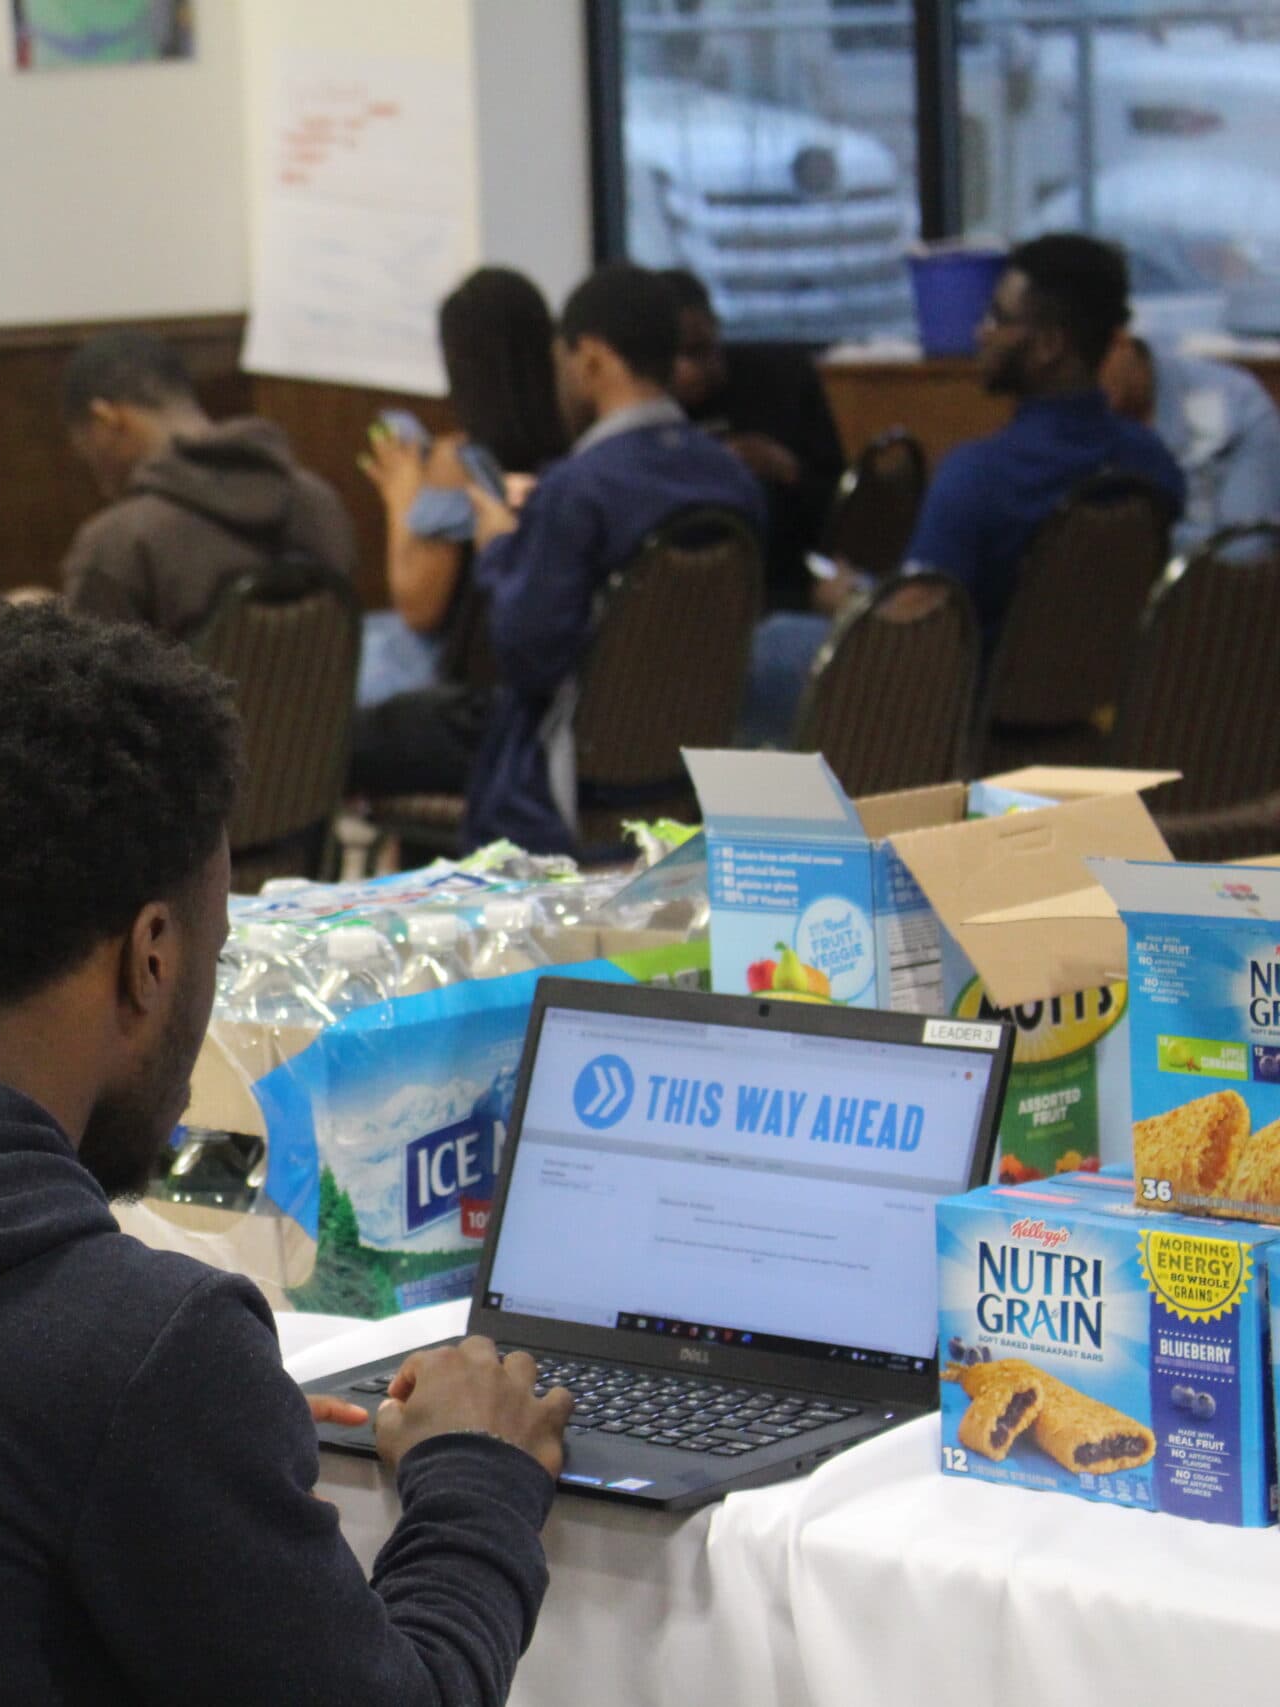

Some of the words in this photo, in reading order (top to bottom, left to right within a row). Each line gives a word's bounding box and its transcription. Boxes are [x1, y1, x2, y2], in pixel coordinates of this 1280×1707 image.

[1162, 944, 1190, 955] FRUIT
[930, 1024, 982, 1042] LEADER
[984, 1029, 993, 1042] 3
[1019, 1088, 1081, 1115] ASSORTED
[646, 1075, 723, 1128] THIS
[735, 1085, 808, 1138] WAY
[810, 1095, 925, 1152] AHEAD
[1033, 1106, 1068, 1127] FRUIT
[418, 1133, 482, 1208] ICE
[1142, 1177, 1172, 1202] 36
[1011, 1219, 1069, 1248] Kellogg's
[1160, 1238, 1230, 1259] MORNING
[978, 1241, 1102, 1300] NUTRI
[1157, 1252, 1233, 1277] ENERGY
[1187, 1274, 1230, 1289] WHOLE
[1174, 1285, 1213, 1303] GRAINS
[977, 1294, 1103, 1350] GRAIN
[679, 1347, 709, 1364] DELL
[979, 1335, 999, 1344] SOFT
[1000, 1338, 1028, 1350] BAKED
[1030, 1342, 1078, 1358] BREAKFAST
[1080, 1350, 1104, 1362] BARS
[1160, 1338, 1231, 1364] BLUEBERRY
[1168, 1434, 1194, 1447] REAL
[1196, 1439, 1225, 1451] FRUIT
[1178, 1428, 1196, 1437] MADE
[1197, 1431, 1215, 1440] WITH
[943, 1447, 969, 1472] 12
[1171, 1448, 1186, 1459] NO
[1188, 1453, 1222, 1464] ARTIFICIAL
[1175, 1469, 1191, 1480] NO
[1189, 1480, 1224, 1493] ARTIFICIAL
